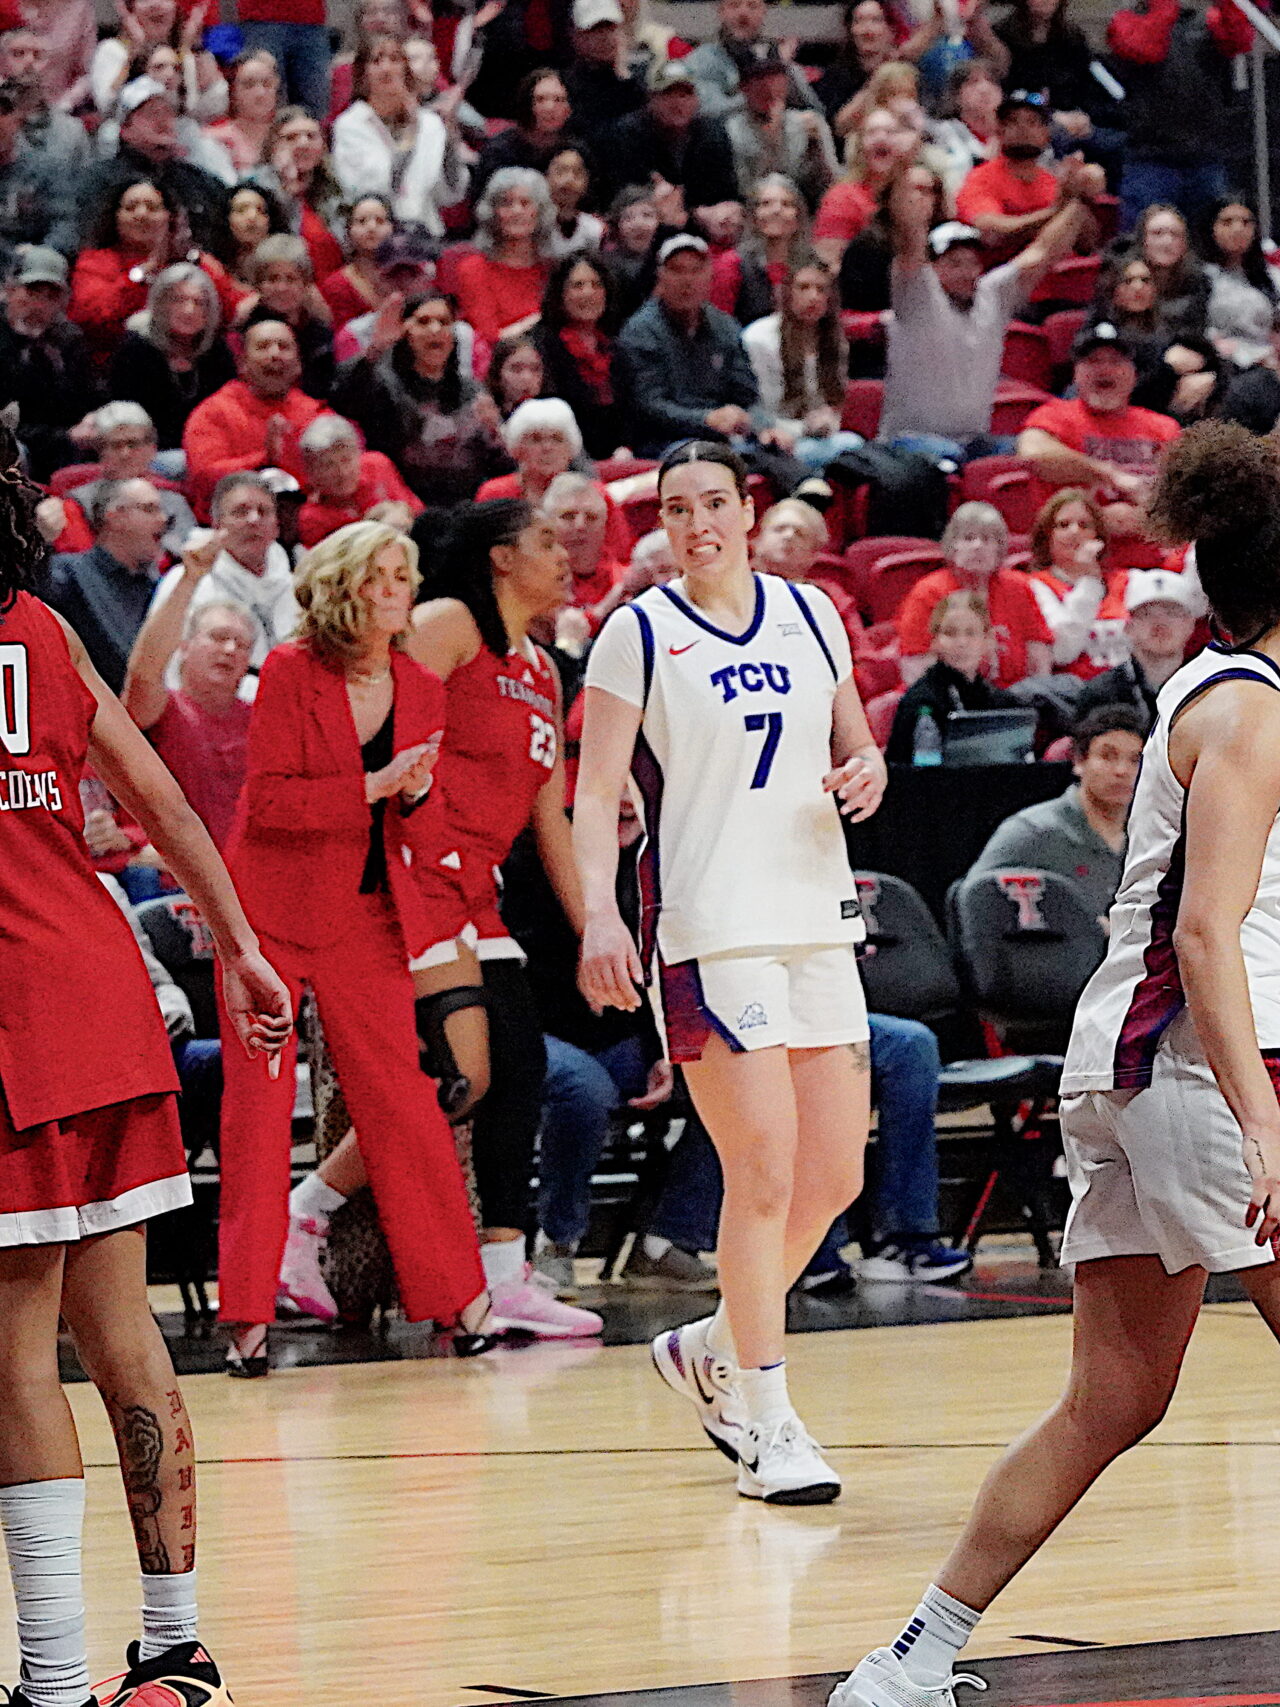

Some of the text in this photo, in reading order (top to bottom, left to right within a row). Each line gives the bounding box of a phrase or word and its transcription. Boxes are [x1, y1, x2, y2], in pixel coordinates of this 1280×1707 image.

[710, 662, 791, 703] TCU
[530, 713, 556, 768] 23
[744, 712, 783, 789] 7
